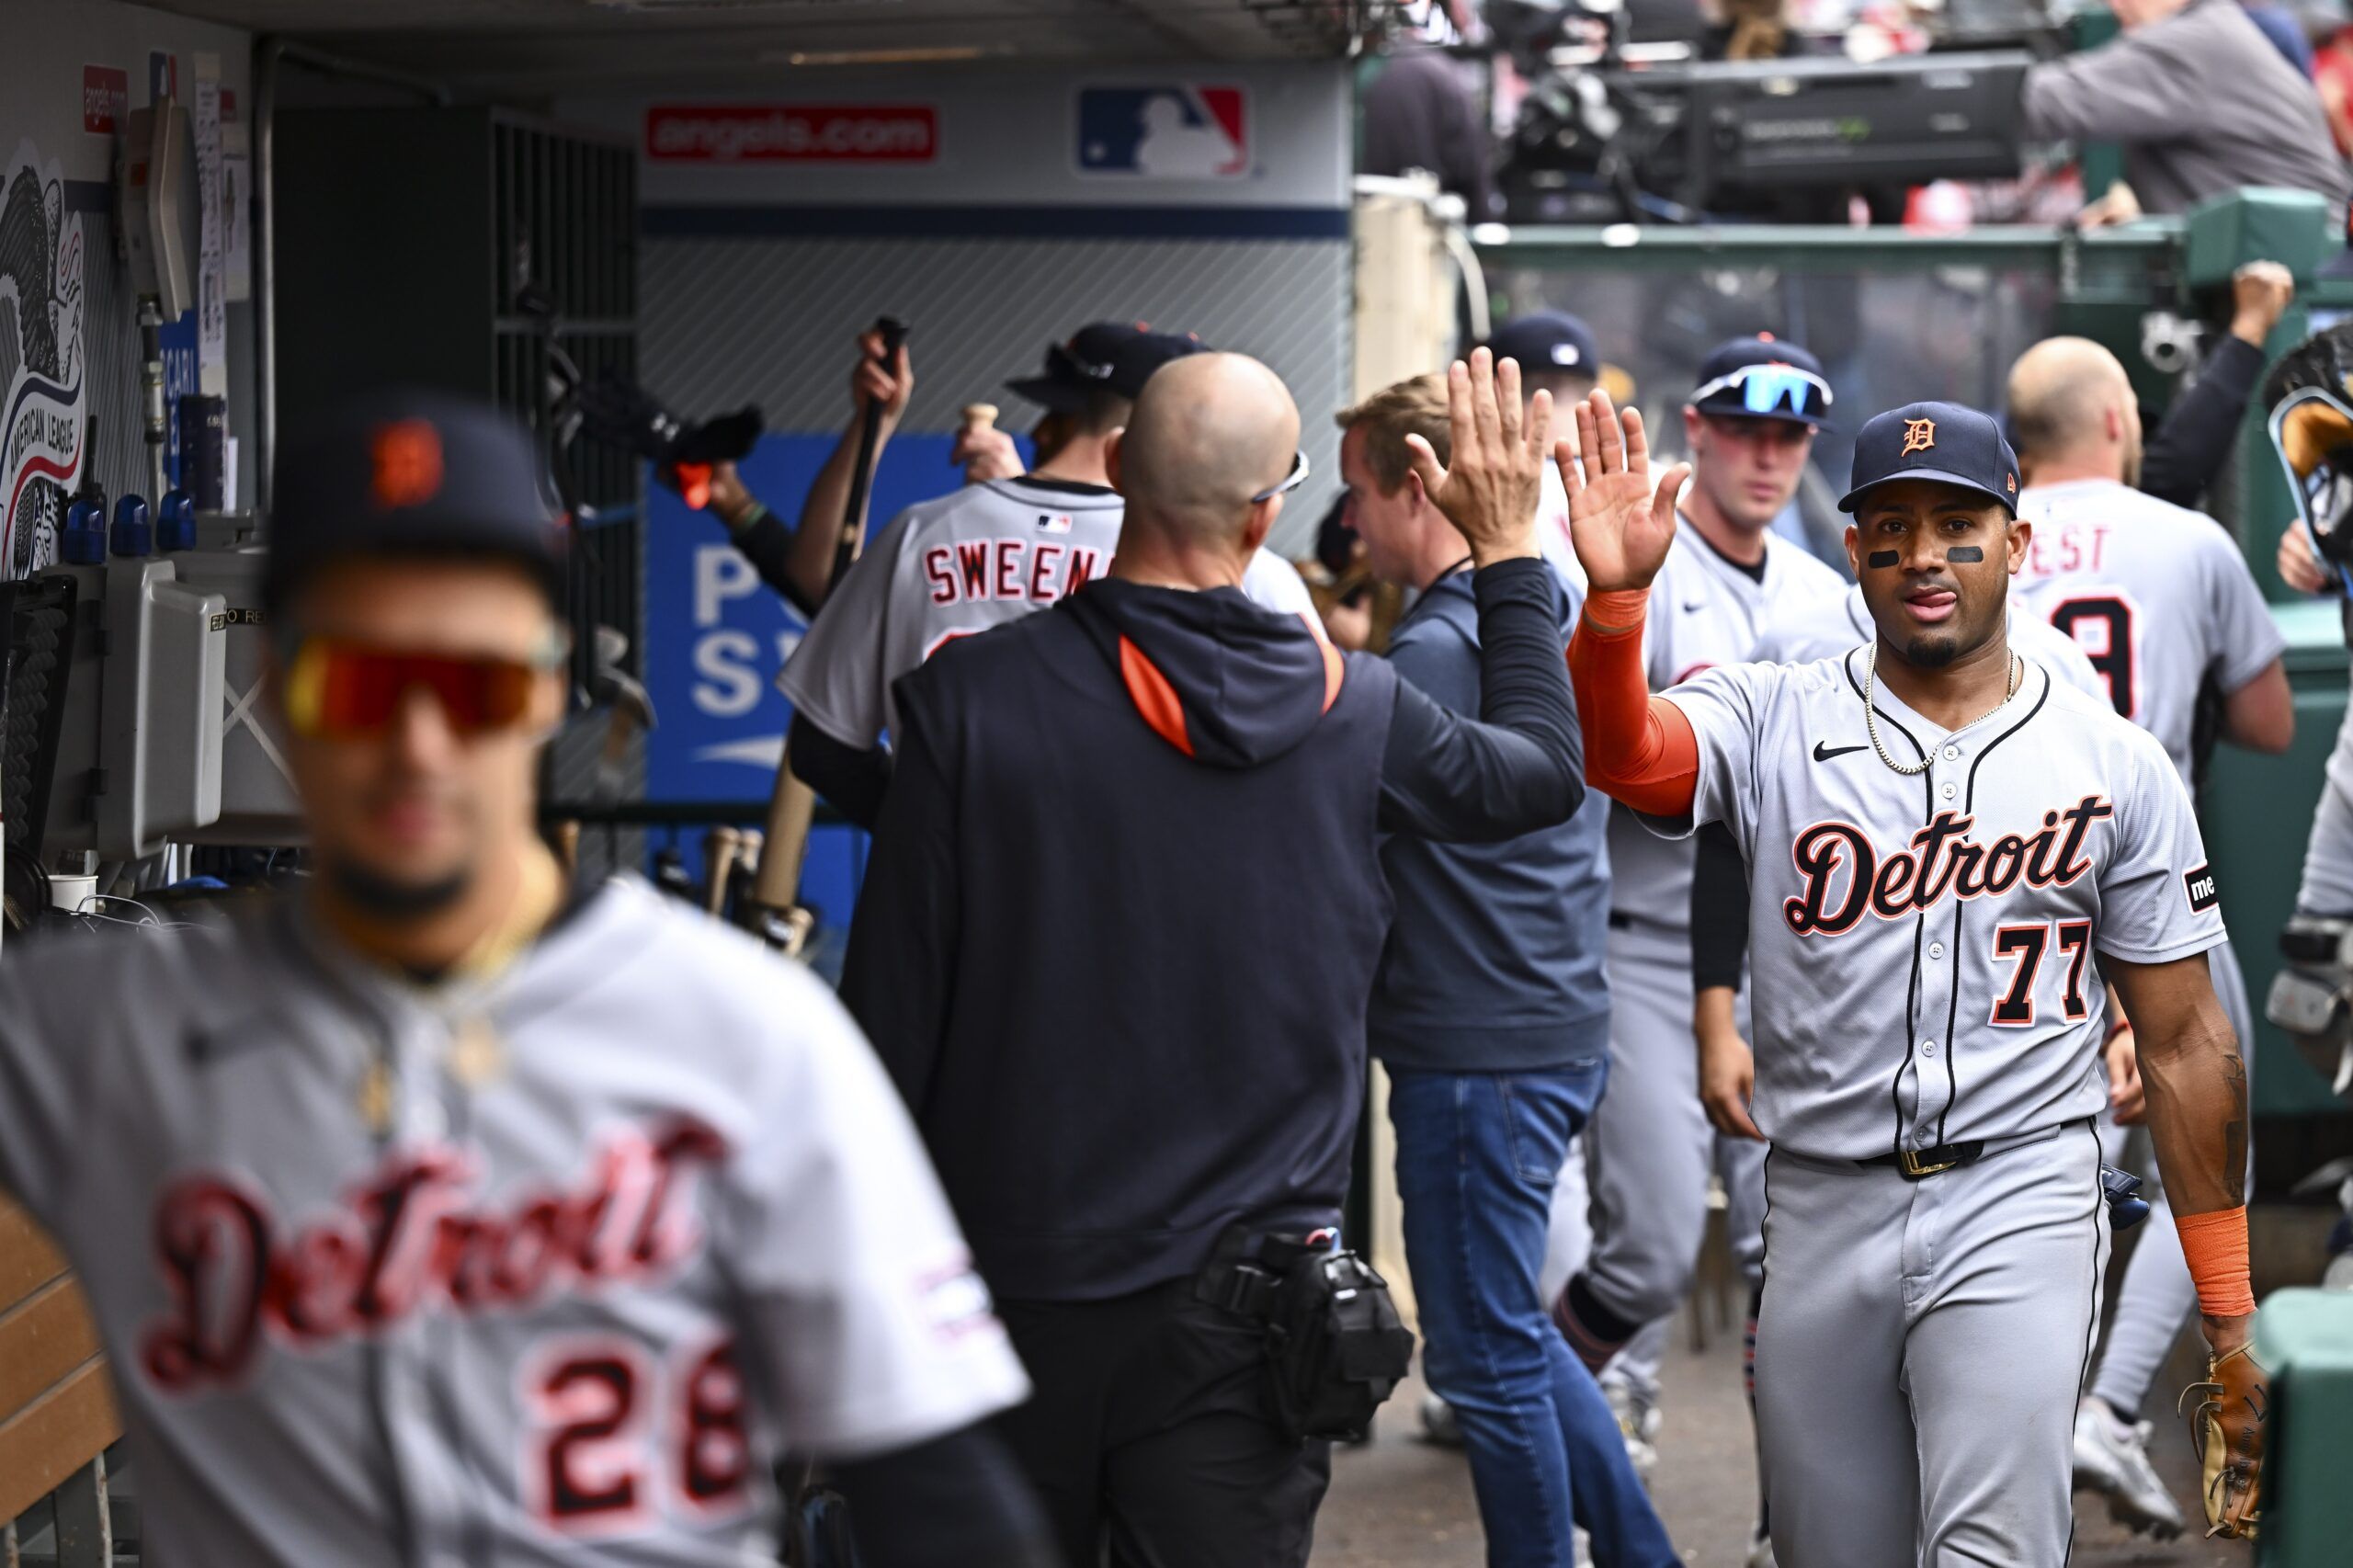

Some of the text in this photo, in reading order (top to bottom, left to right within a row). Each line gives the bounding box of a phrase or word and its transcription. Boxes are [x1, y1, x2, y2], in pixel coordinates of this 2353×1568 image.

[654, 109, 930, 158] angels.com
[10, 408, 74, 483] AMERICAN LEAGUE
[1901, 418, 1937, 458] D
[925, 538, 1115, 607] SWEEN
[1784, 795, 2114, 936] Detroit
[1988, 917, 2092, 1028] 77
[138, 1114, 731, 1397] Detroit
